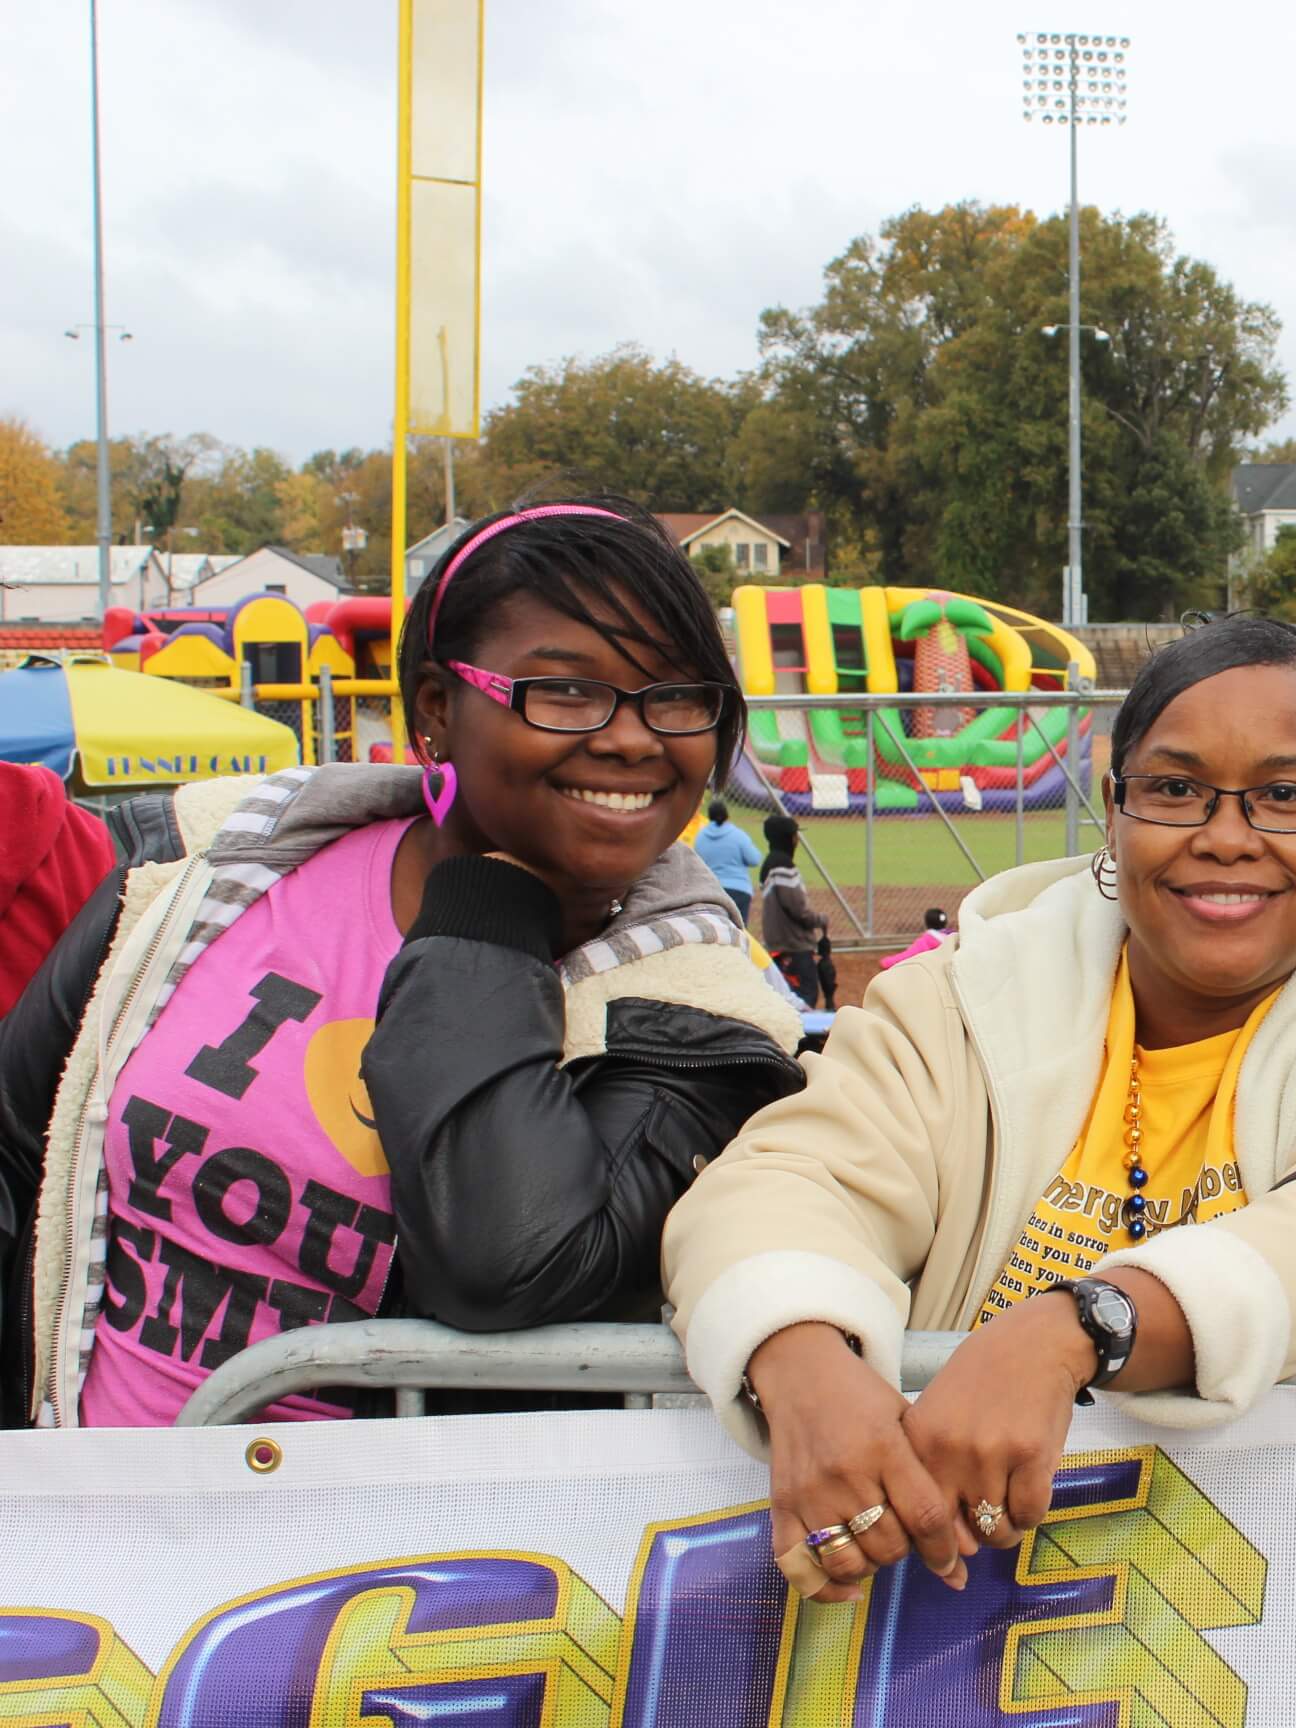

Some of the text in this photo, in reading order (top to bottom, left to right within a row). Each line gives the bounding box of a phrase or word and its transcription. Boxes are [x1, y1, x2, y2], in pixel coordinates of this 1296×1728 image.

[184, 971, 324, 1101] I
[121, 1094, 399, 1300] YOU
[1027, 1212, 1049, 1232] hen
[1049, 1222, 1065, 1239] in
[1010, 1251, 1032, 1274] hen
[1019, 1231, 1040, 1252] hen
[1041, 1245, 1070, 1264] you
[1000, 1271, 1022, 1292] hen
